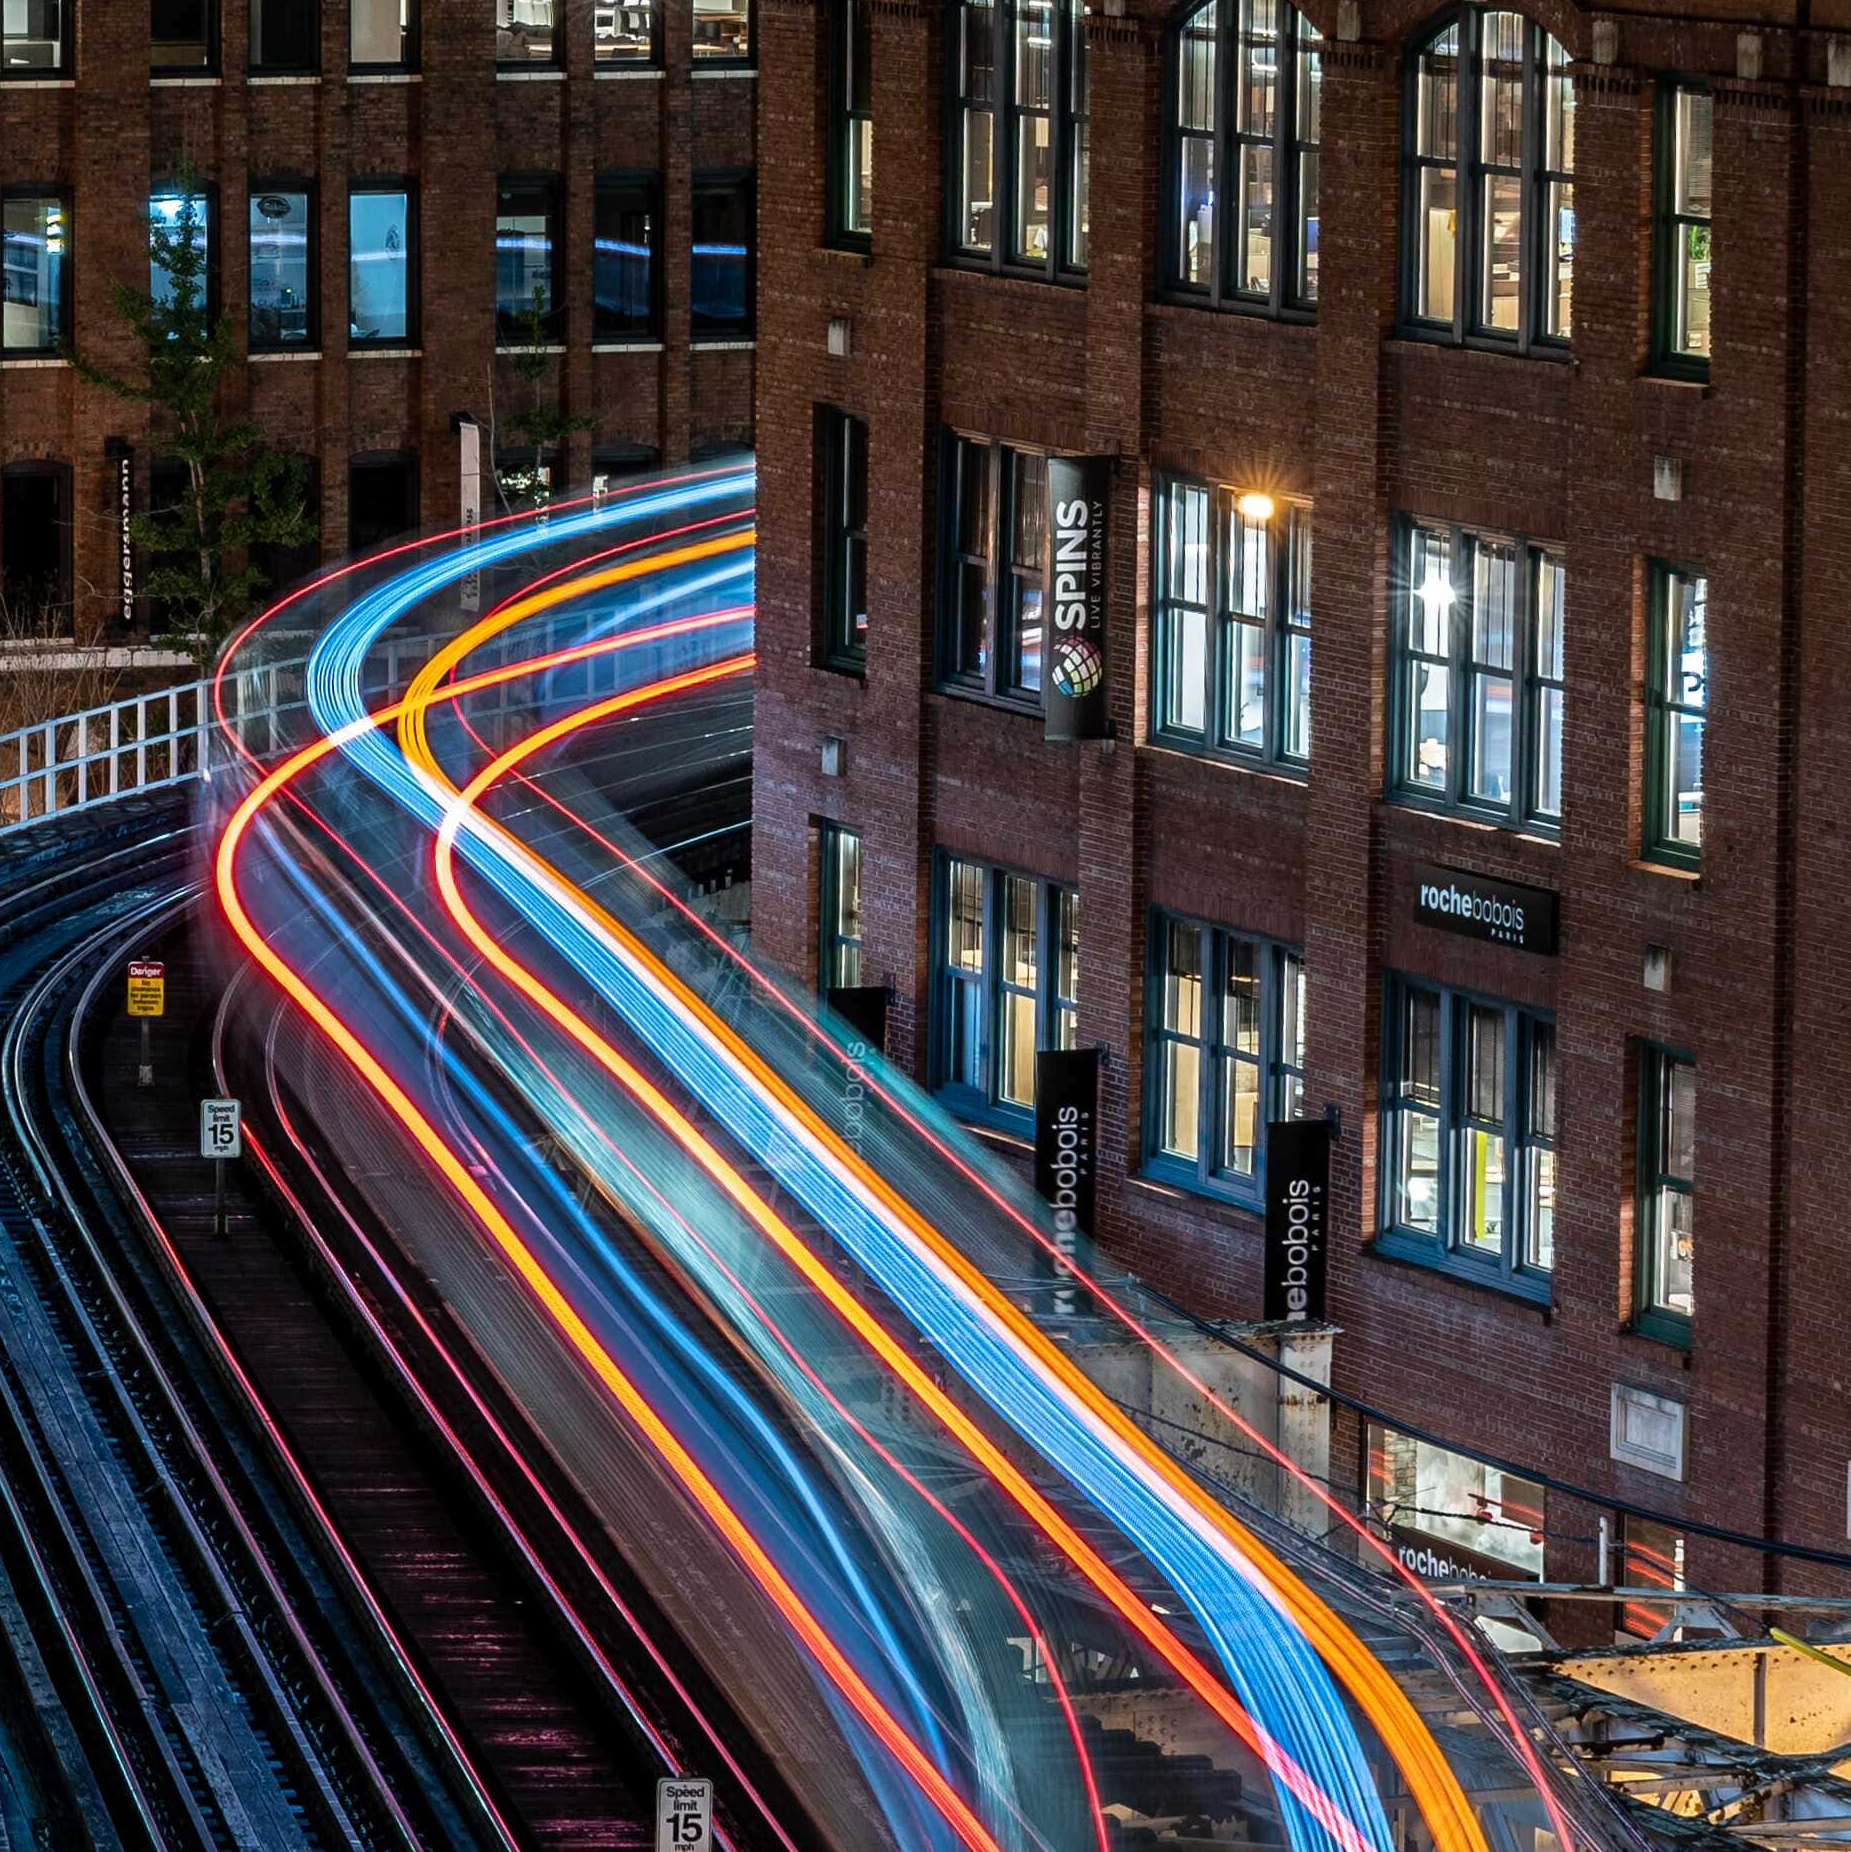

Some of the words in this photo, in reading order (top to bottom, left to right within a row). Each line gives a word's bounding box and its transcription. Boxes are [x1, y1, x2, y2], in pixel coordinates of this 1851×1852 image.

[1091, 501, 1103, 588] VIBRANTLY
[1055, 500, 1088, 630] SPINS
[1090, 595, 1101, 629] LIVE
[1421, 884, 1524, 930] rochebobois
[1490, 927, 1525, 945] PARIS
[207, 1104, 236, 1115] Speed
[212, 1115, 231, 1123] limit
[207, 1123, 235, 1146] 15
[666, 1785, 705, 1800] Speed
[673, 1800, 698, 1812] limit
[666, 1813, 703, 1843] 15
[674, 1843, 696, 1852] mph
